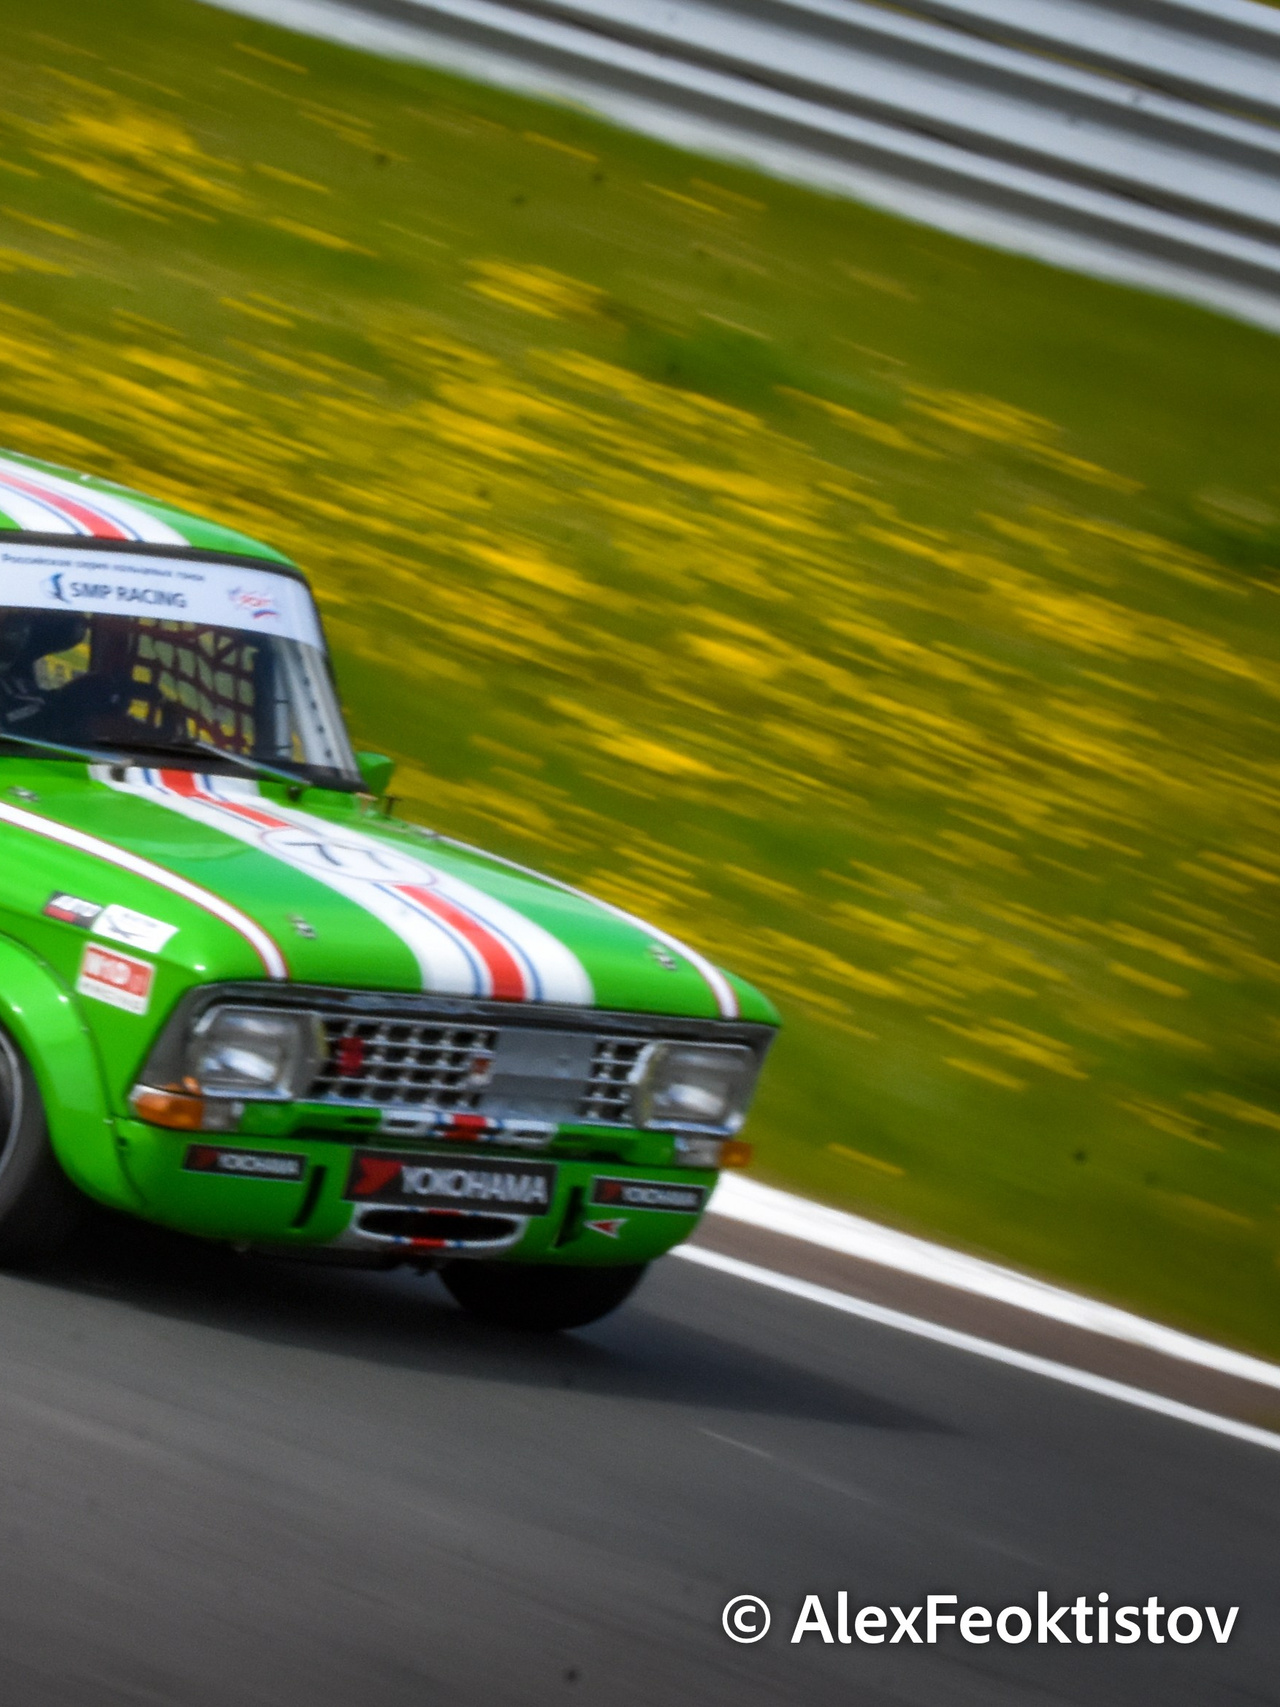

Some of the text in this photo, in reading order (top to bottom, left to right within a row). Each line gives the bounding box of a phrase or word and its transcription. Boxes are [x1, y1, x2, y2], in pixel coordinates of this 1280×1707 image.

[70, 581, 188, 609] SMP RACING
[401, 1164, 549, 1204] YOKOHAMA
